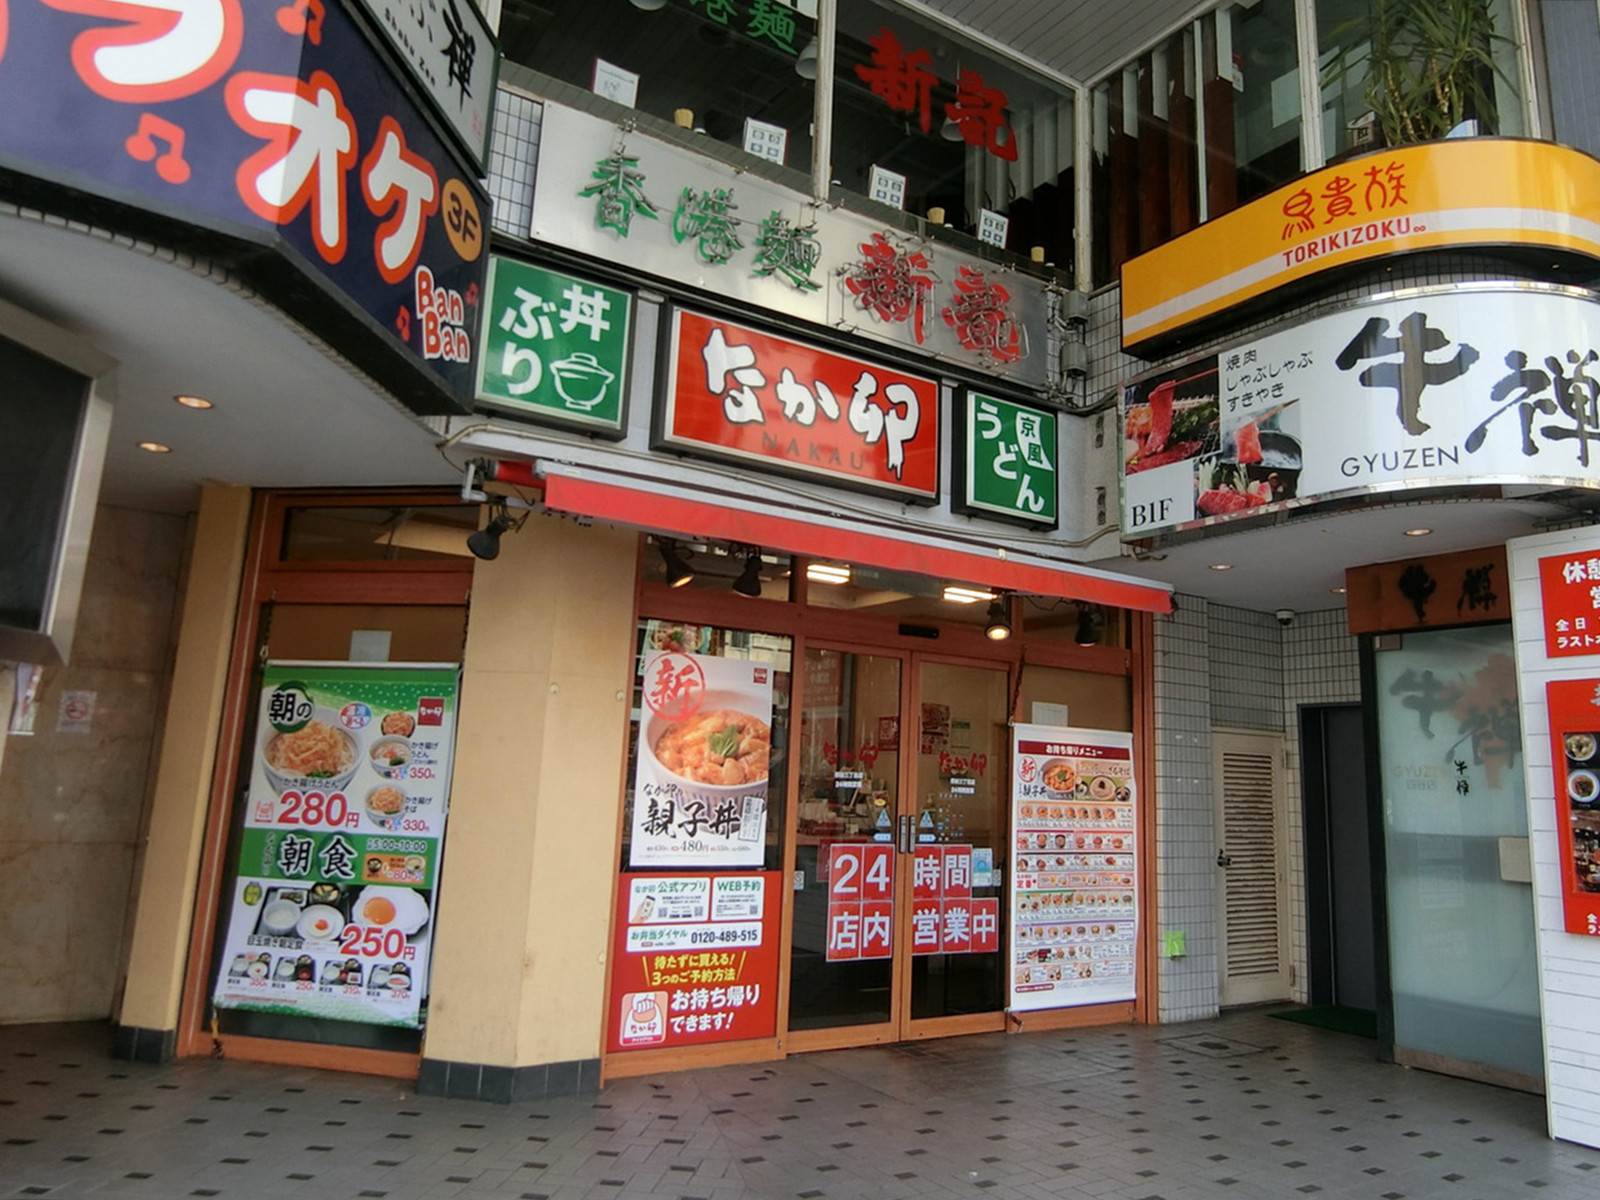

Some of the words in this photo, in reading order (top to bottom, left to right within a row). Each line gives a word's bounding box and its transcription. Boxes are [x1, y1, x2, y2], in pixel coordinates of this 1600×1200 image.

[446, 190, 478, 243] 3F
[1281, 216, 1412, 268] TORIKIZOKU
[415, 265, 464, 326] Ban
[422, 306, 470, 364] Ban
[1226, 349, 1257, 372] 焼肉
[1226, 351, 1314, 392] しゃぶしゃぶ
[701, 327, 920, 480] なか卯
[1227, 382, 1284, 412] すきやき
[761, 431, 866, 471] NAKAU
[977, 403, 1044, 513] うどん
[1017, 415, 1046, 464] 京風
[1340, 446, 1460, 477] GYUZEN
[1130, 497, 1174, 528] B1F
[268, 692, 313, 722] 朝の
[650, 658, 700, 718] 新
[939, 750, 988, 776] なか卯
[277, 791, 360, 829] 280円
[640, 798, 741, 840] 親子丼
[279, 835, 357, 879] 朝食
[833, 854, 890, 893] 24
[913, 854, 971, 891] 時間
[717, 880, 761, 892] WEB予約
[340, 924, 416, 961] 250円
[690, 929, 758, 944] 0120-489-515
[829, 911, 891, 951] 店内
[912, 907, 996, 945] 営業中
[670, 984, 760, 1012] お持ち帰り
